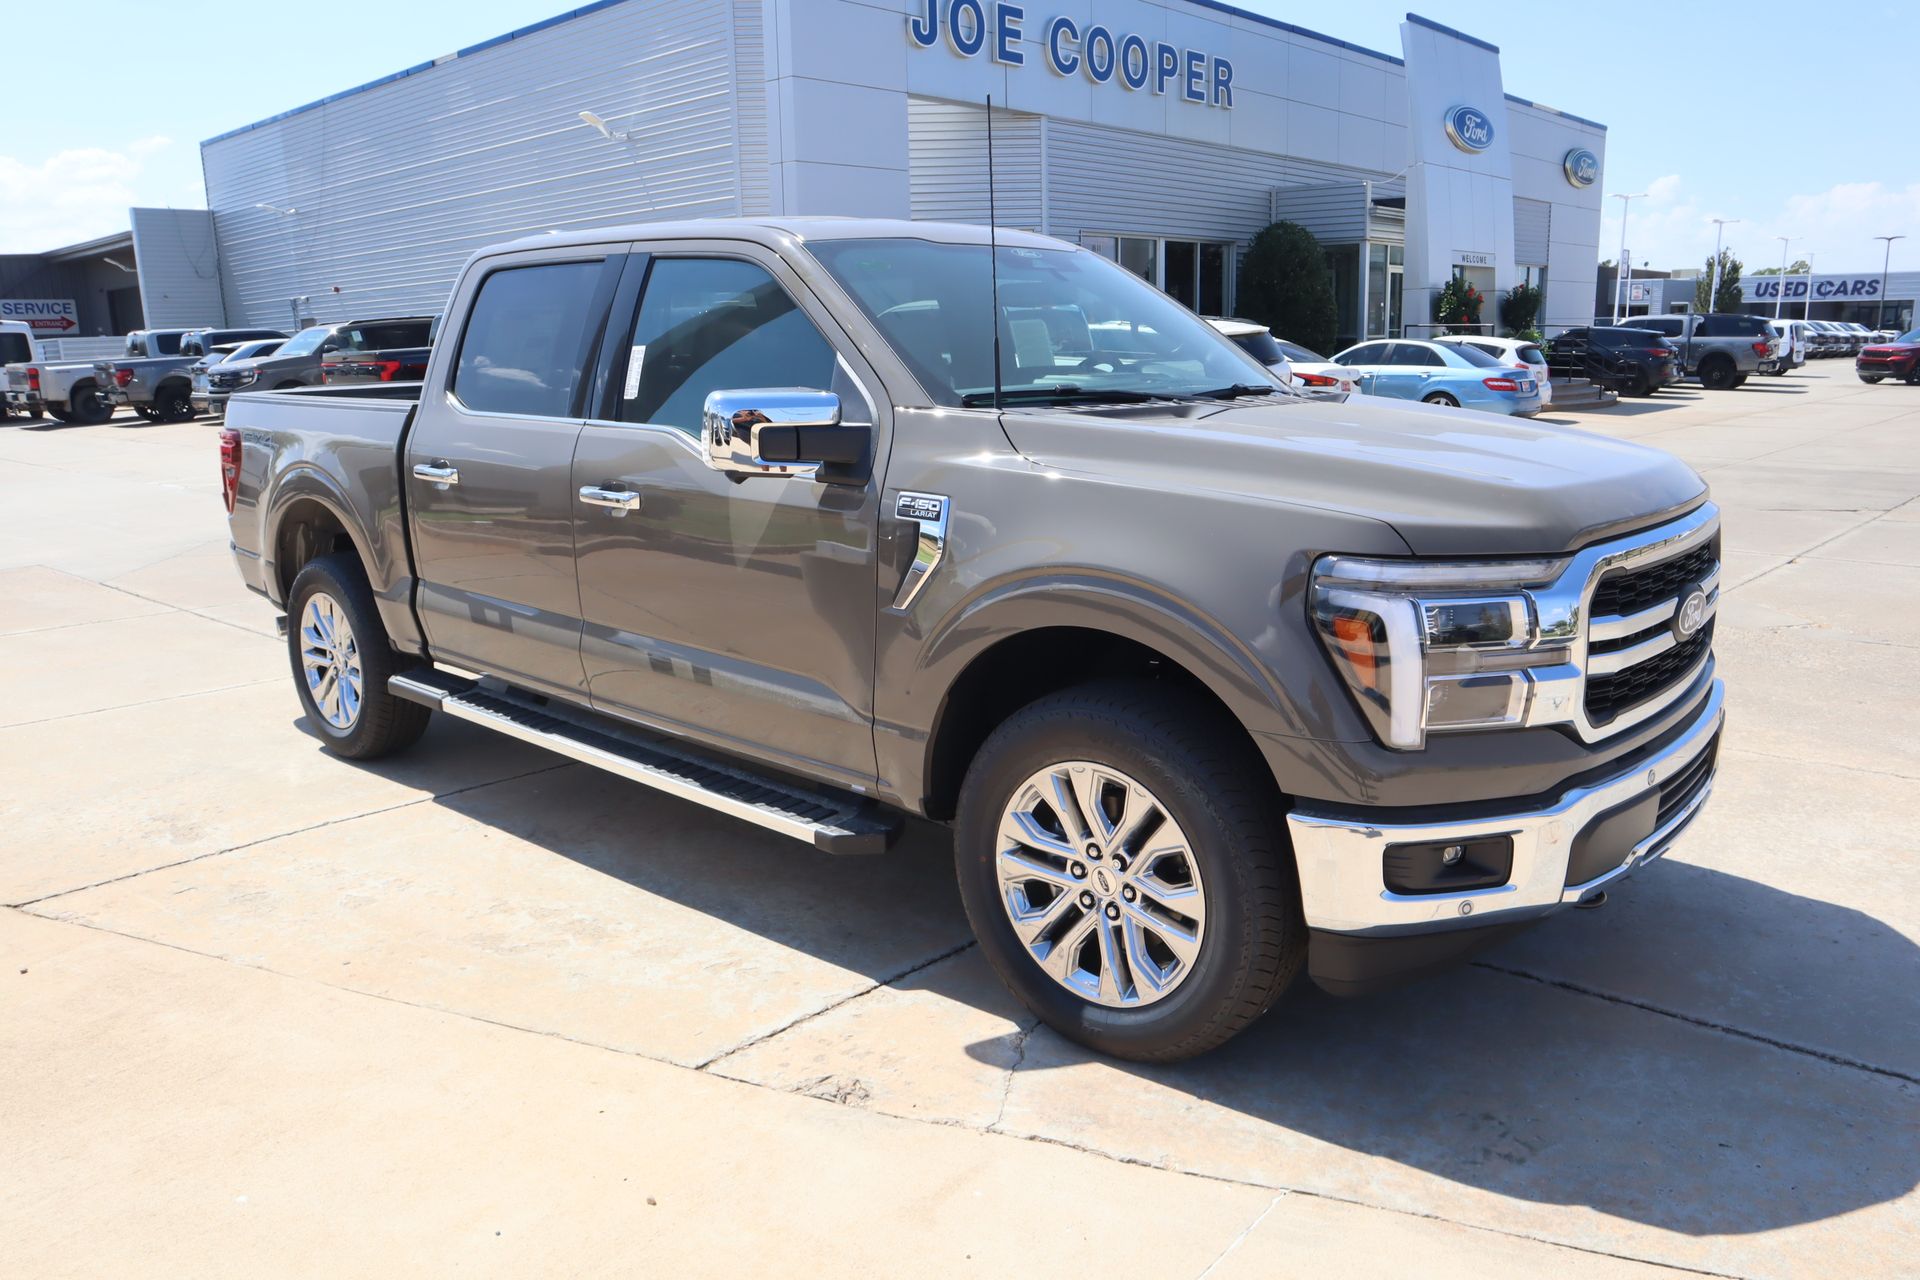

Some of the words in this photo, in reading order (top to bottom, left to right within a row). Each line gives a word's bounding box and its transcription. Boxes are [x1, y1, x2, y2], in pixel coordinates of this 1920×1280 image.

[908, 0, 1025, 66] JOE
[1046, 16, 1234, 109] COOPER
[1463, 114, 1488, 142] Ford
[1461, 254, 1487, 264] WELCOME
[1755, 281, 1808, 297] USED
[1816, 279, 1880, 296] CARS
[2, 302, 73, 315] SERVICE
[34, 320, 67, 328] ENTRANCE
[899, 497, 940, 511] F-150
[910, 509, 938, 518] LARIAT
[1684, 598, 1703, 629] Ford
